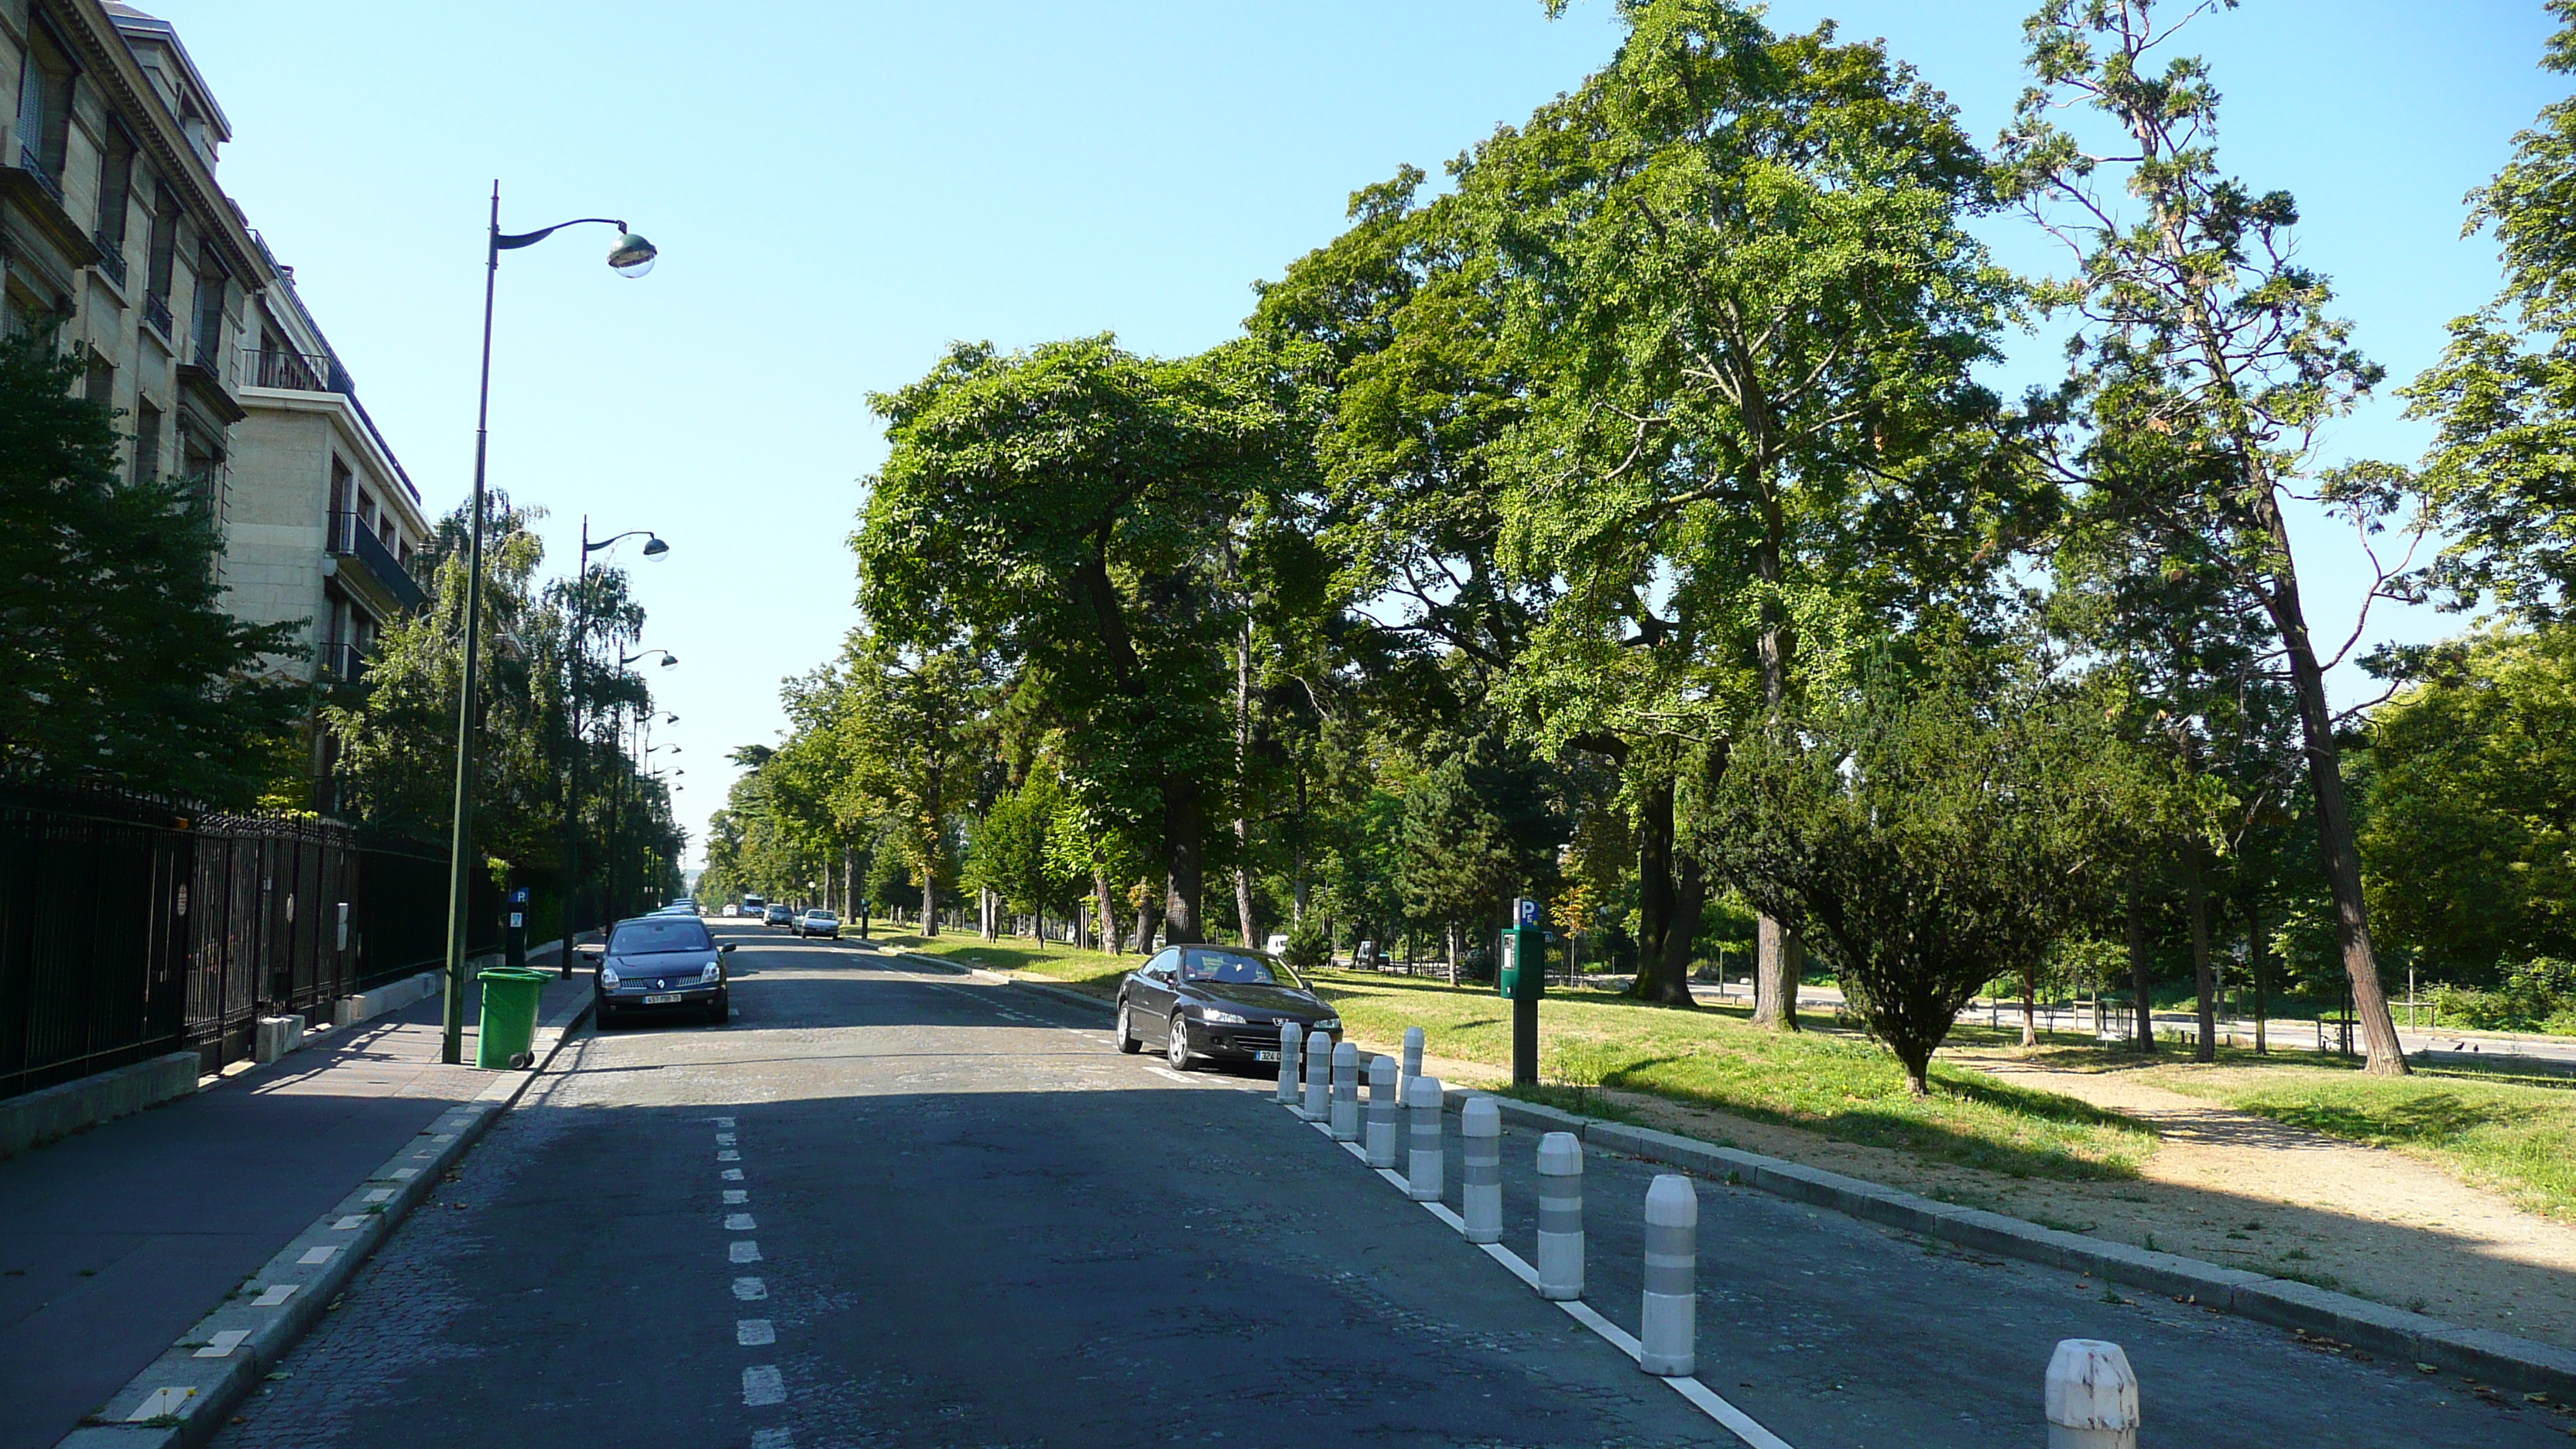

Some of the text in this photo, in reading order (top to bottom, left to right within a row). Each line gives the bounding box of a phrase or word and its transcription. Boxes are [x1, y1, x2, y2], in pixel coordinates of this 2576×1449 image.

[518, 892, 526, 902] P
[1522, 901, 1535, 919] P
[1262, 1051, 1274, 1060] 324
